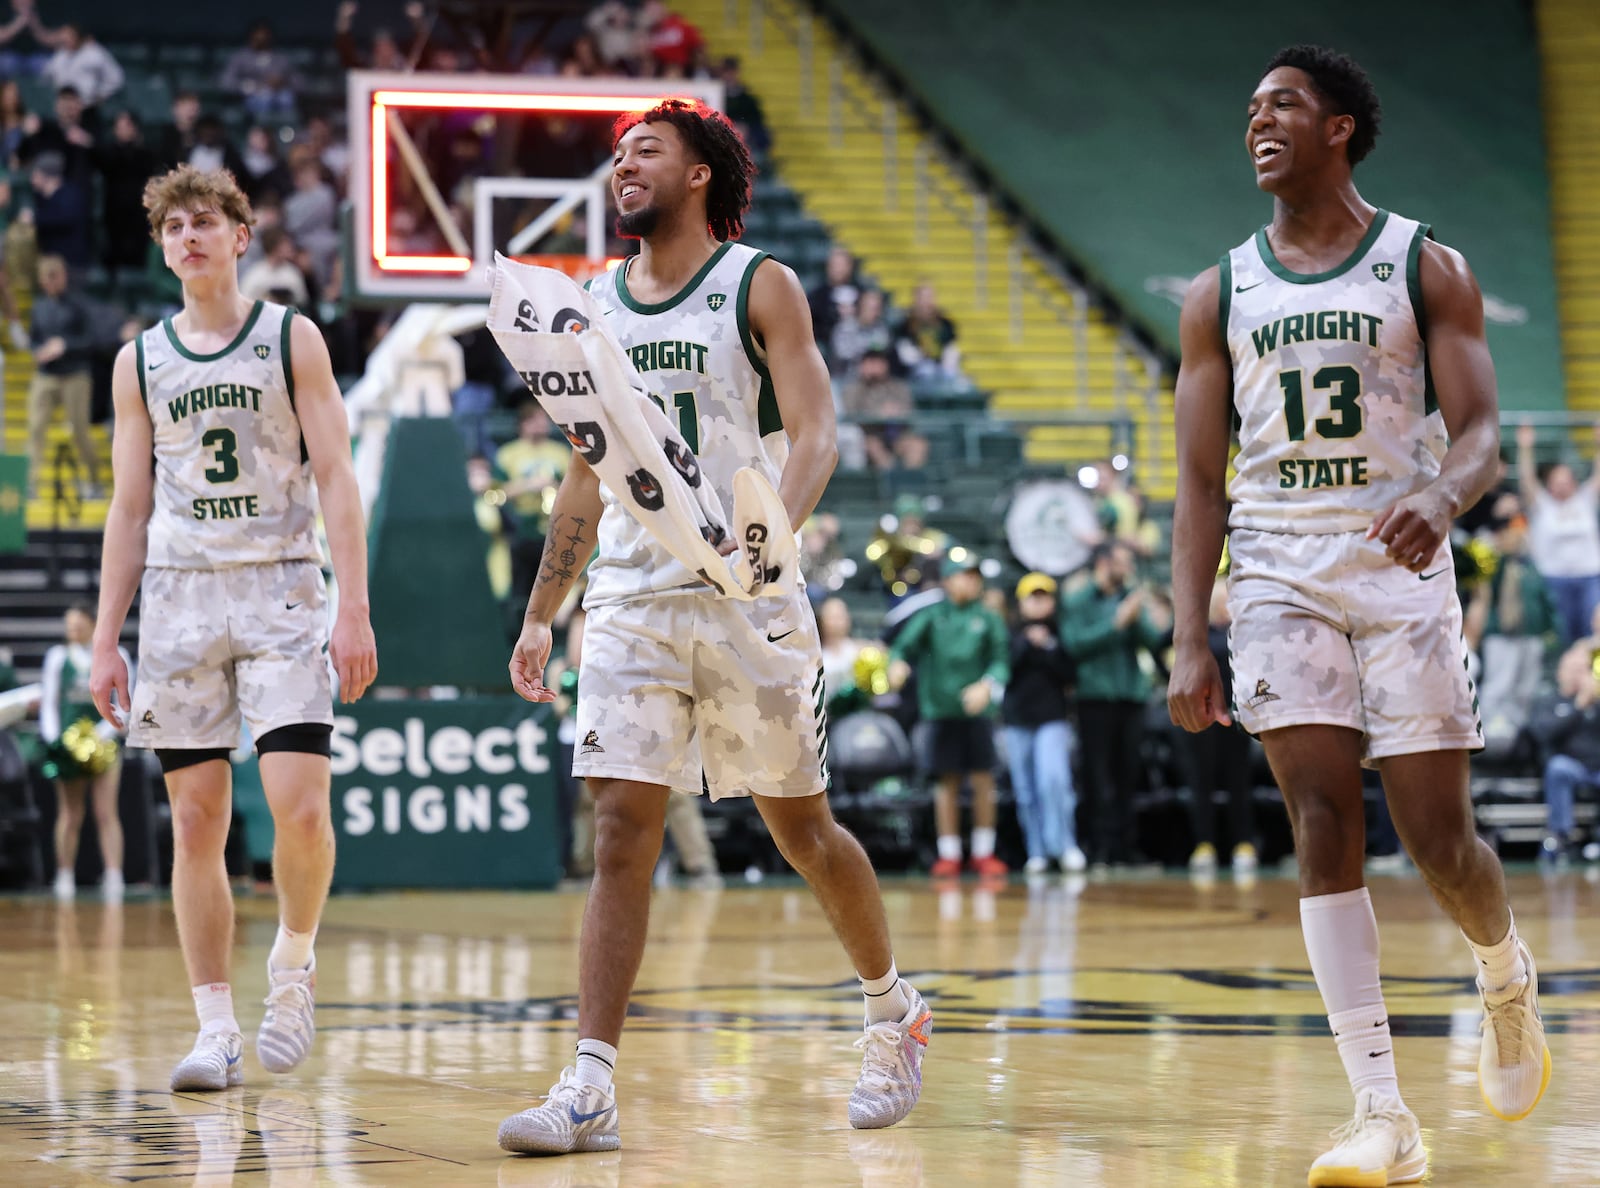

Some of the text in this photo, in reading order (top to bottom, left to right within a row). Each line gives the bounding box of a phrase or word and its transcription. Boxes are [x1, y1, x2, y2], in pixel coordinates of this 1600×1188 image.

[1251, 310, 1383, 360] WRIGHT
[168, 383, 262, 423] WRIGHT
[1279, 366, 1363, 442] 13
[201, 427, 239, 484] 3
[1278, 457, 1368, 489] STATE
[192, 495, 259, 521] STATE
[330, 715, 551, 778] Select
[342, 783, 531, 836] SIGNS
